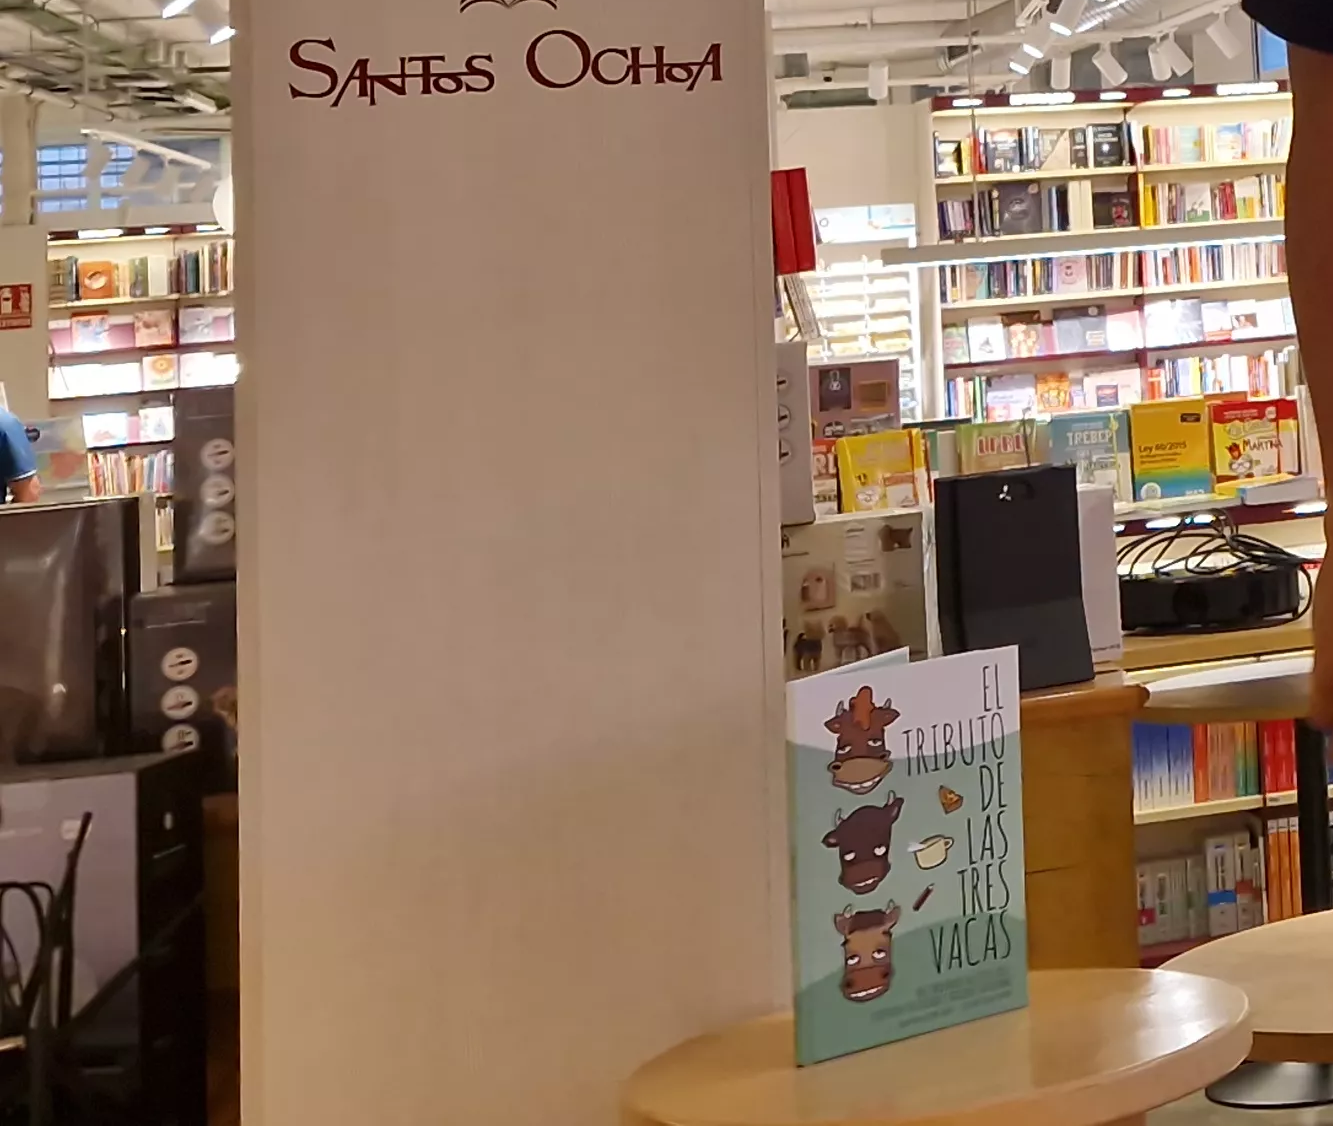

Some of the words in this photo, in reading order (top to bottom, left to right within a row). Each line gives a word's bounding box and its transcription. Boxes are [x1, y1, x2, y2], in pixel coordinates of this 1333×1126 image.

[981, 664, 1004, 712] EL
[902, 711, 1006, 777] TRIBUTO
[979, 762, 1007, 812] DE
[966, 809, 1008, 865] LAS
[957, 859, 1010, 917] TRES
[929, 909, 1012, 975] VACAS
